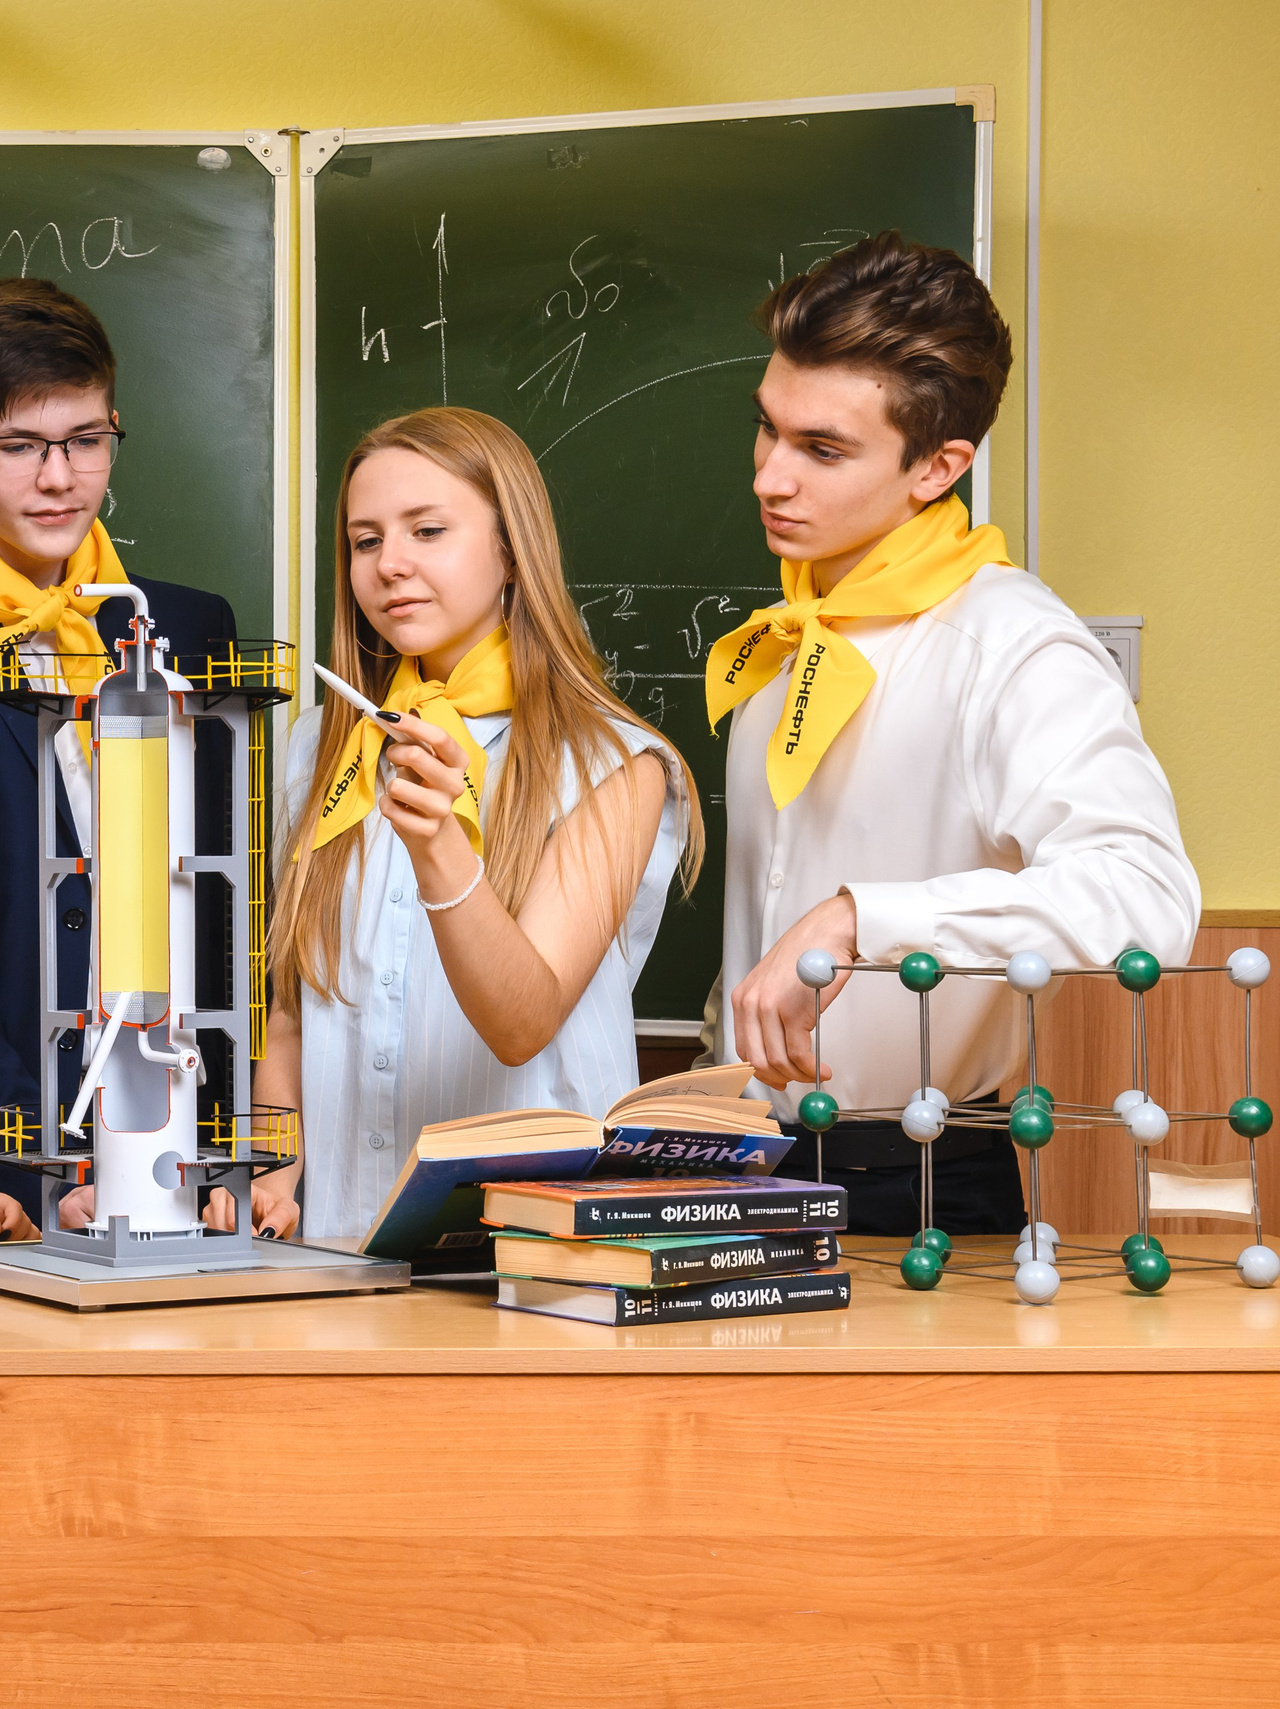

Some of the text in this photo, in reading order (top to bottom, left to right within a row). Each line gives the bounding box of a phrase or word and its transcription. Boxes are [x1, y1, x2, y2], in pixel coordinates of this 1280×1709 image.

[785, 643, 826, 755] РОСНЕФТЬ
[608, 1140, 766, 1165] ФИЗИКА
[640, 1159, 714, 1168] МЕХАНИКА
[660, 1203, 742, 1223] ФИЗИКА
[747, 1207, 799, 1215] ЭЛЕКТРОДИНАМИКА
[809, 1201, 821, 1217] 11
[826, 1199, 839, 1218] 10
[710, 1248, 766, 1269] ФИЗИКА
[770, 1248, 804, 1259] МЕХАНИКА
[815, 1236, 830, 1261] 10
[624, 1299, 636, 1318] 10
[641, 1299, 652, 1315] 11
[710, 1288, 783, 1310] ФИЗИКА
[787, 1289, 834, 1299] ЭЛЕКТРОДИНАМИКА
